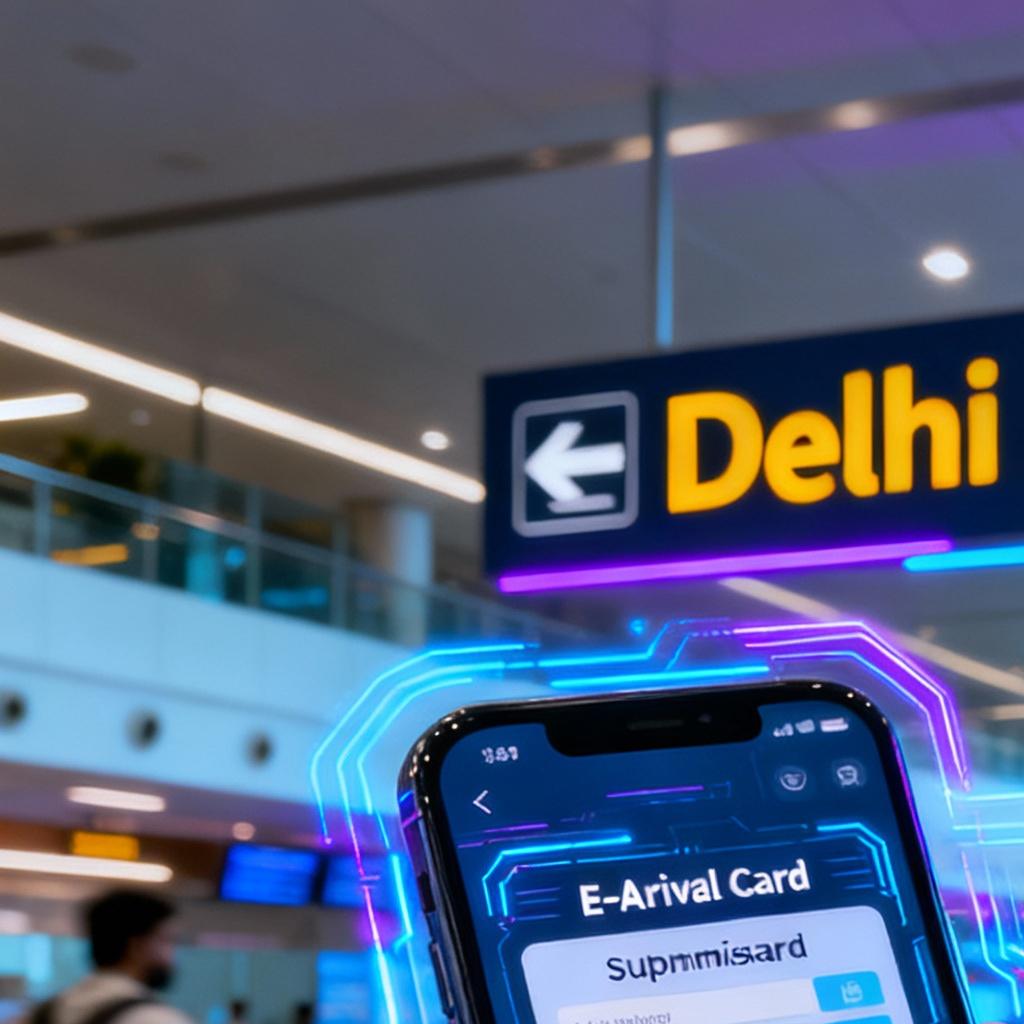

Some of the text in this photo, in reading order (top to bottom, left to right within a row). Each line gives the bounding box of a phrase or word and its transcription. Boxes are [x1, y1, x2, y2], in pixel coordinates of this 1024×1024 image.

[667, 358, 999, 514] Delhi
[579, 857, 811, 916] E-Arival Card
